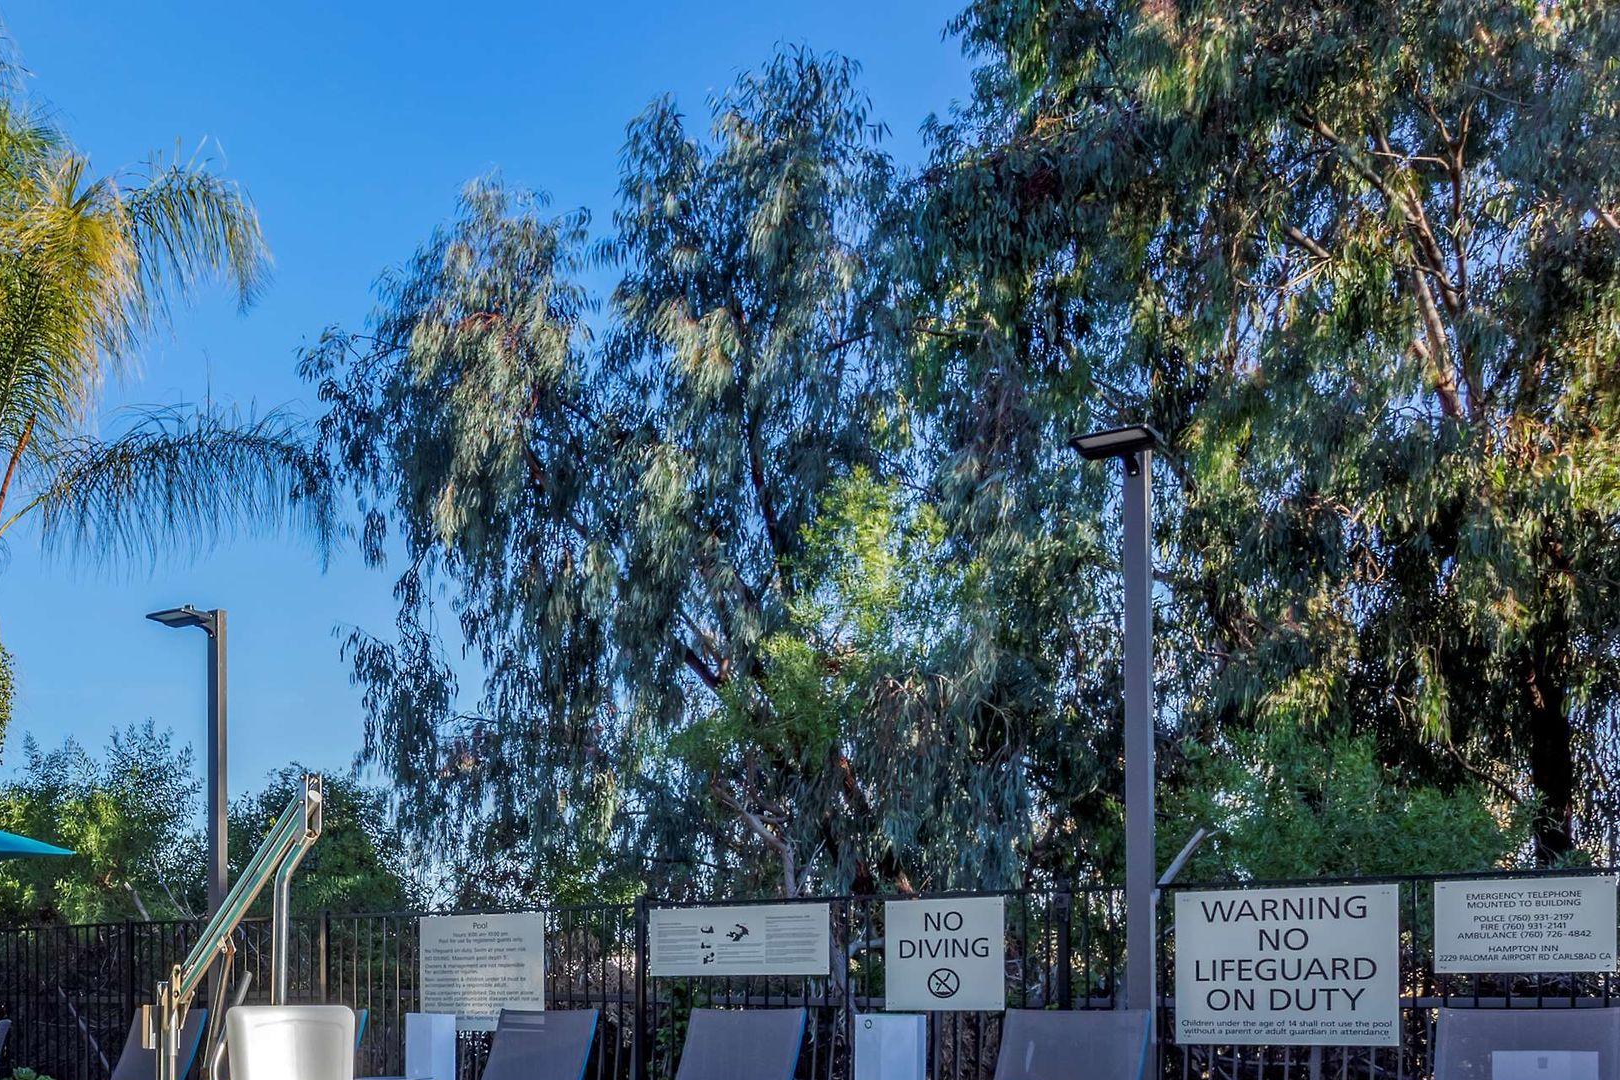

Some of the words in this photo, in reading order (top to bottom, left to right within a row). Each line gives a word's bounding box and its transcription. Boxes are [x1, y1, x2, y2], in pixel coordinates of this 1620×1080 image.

[1466, 892, 1523, 901] EMERGENCY
[1528, 890, 1582, 899] TELEPHONE
[1201, 895, 1368, 923] WARNING
[1467, 901, 1516, 909] MOUNTED
[1535, 899, 1581, 907] BUILDING
[924, 911, 963, 932] NO
[1473, 914, 1505, 923] POLICE
[1508, 914, 1531, 922] (760)
[1480, 923, 1499, 931] FIRE
[1502, 922, 1525, 930] (760)
[1258, 927, 1309, 951] NO
[1457, 931, 1517, 940] AMBULANCE
[1520, 931, 1543, 939] (760)
[899, 937, 990, 959] DIVING
[1488, 945, 1539, 953] HAMPTON
[1459, 954, 1499, 962] PALOMAR
[1501, 953, 1536, 961] AIRPORT
[1538, 953, 1550, 961] RD
[1552, 952, 1597, 961] CARLSBAD
[1599, 952, 1612, 960] CA
[1195, 957, 1377, 982] LIFEGUARD
[1206, 988, 1255, 1011] ON
[1270, 987, 1366, 1011] DUTY
[1181, 1019, 1215, 1027] Children
[1216, 1019, 1241, 1027] under
[1242, 1019, 1257, 1027] the
[1276, 1019, 1286, 1027] of
[1288, 1019, 1298, 1027] 14
[1299, 1019, 1319, 1027] shall
[1354, 1019, 1370, 1027] the
[1372, 1019, 1393, 1029] pool
[1184, 1027, 1216, 1035] without
[1225, 1028, 1252, 1037] parent
[1265, 1027, 1287, 1035] adult
[1289, 1027, 1328, 1037] guardian
[1330, 1027, 1338, 1035] in
[1340, 1027, 1390, 1035] attendance
